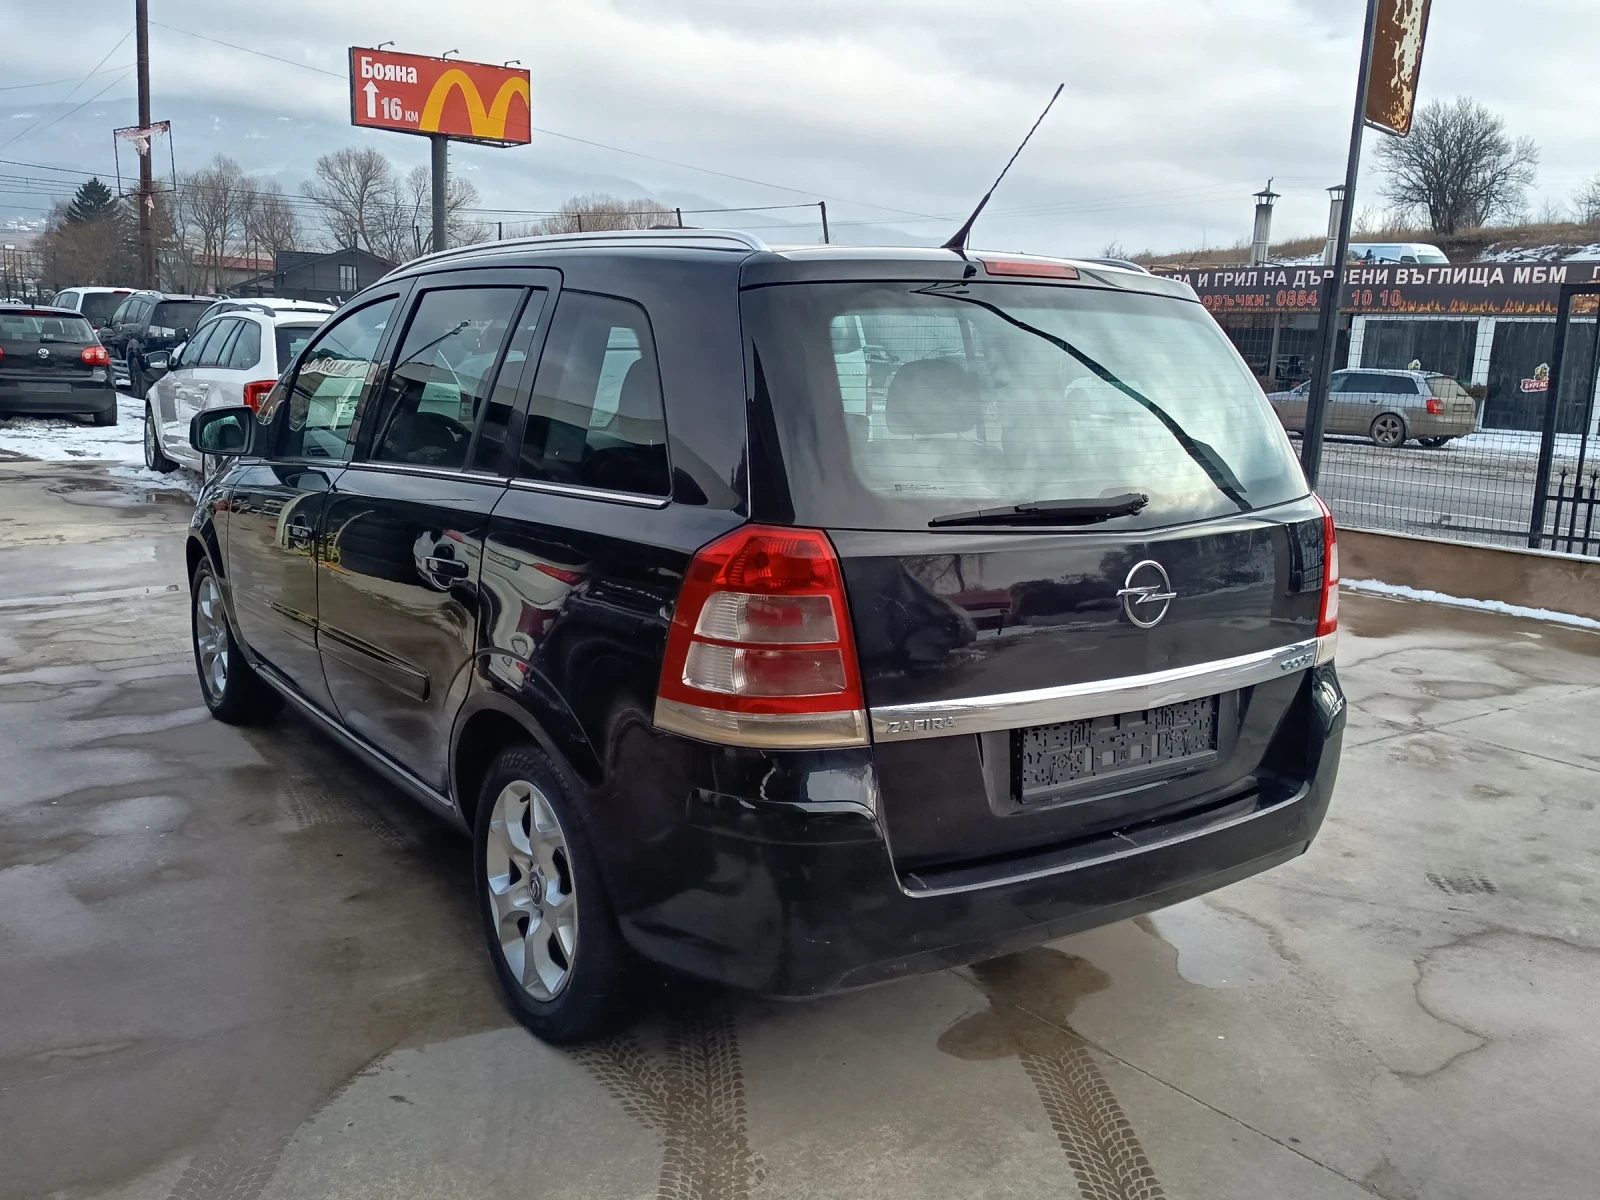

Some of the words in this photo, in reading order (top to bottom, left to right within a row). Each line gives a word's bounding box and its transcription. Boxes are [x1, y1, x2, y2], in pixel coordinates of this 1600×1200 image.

[361, 56, 418, 84] Бояна
[381, 97, 402, 121] 16
[1198, 273, 1208, 287] И
[1214, 271, 1257, 287] ГРИЛ
[1264, 271, 1287, 286] НА
[1395, 267, 1505, 287] ВЪГЛИЩА
[1513, 266, 1567, 284] МБМ
[1199, 294, 1270, 311] оръчки:
[1276, 290, 1317, 307] 0884
[1352, 289, 1372, 306] 10
[1380, 289, 1401, 307] 10
[886, 716, 957, 734] ZAFIRA
